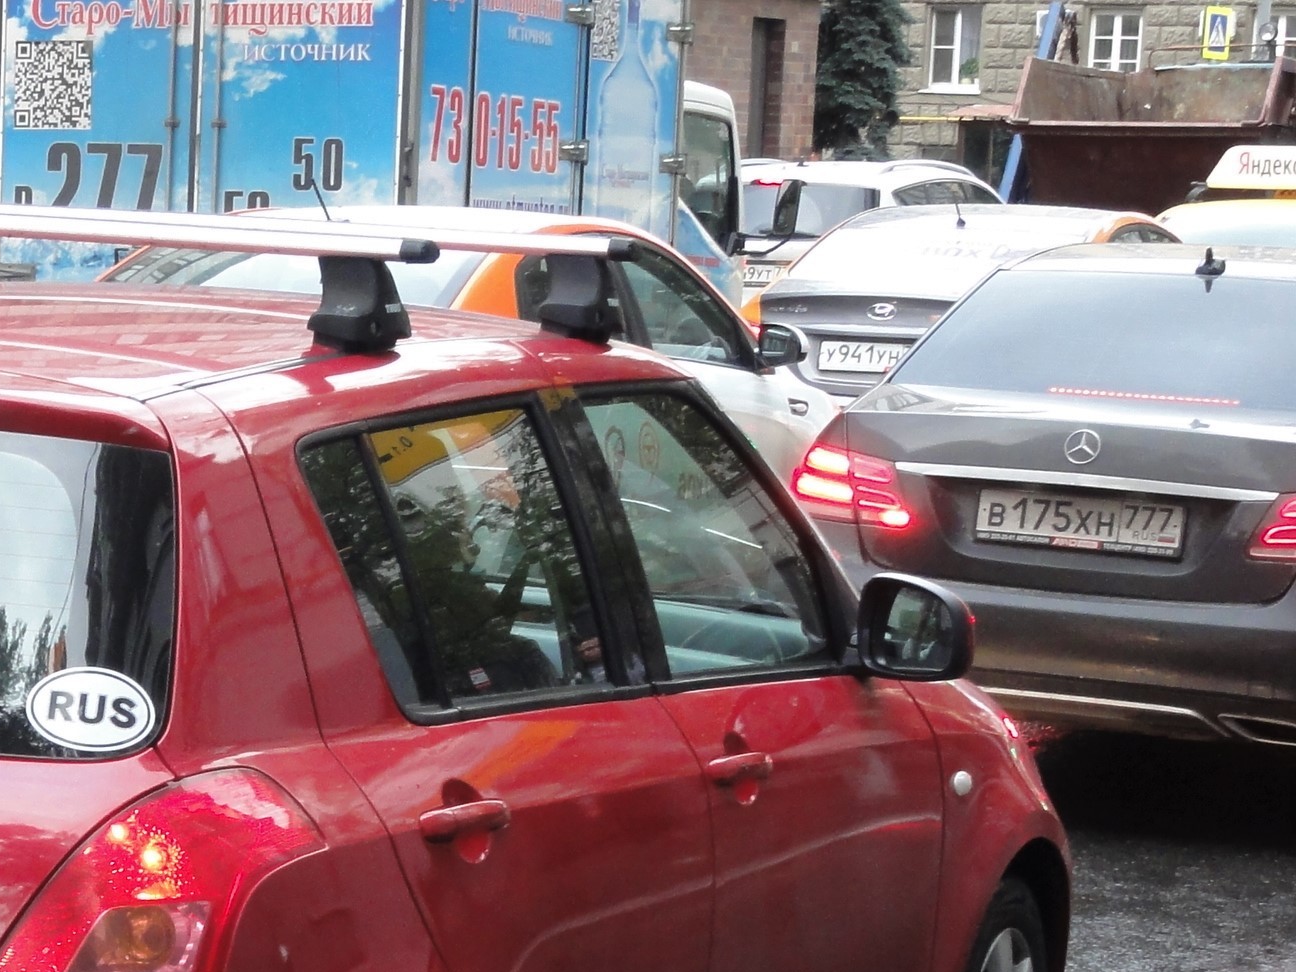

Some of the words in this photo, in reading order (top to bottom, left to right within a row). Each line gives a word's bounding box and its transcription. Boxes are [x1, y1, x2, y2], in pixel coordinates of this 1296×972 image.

[243, 43, 372, 62] ИСТОЧНИК
[47, 142, 163, 210] 277
[293, 137, 344, 191] 50
[987, 498, 1115, 537] В175ХН
[1125, 505, 1174, 531] 777
[1133, 530, 1157, 541] RUS
[48, 690, 137, 729] RUS
